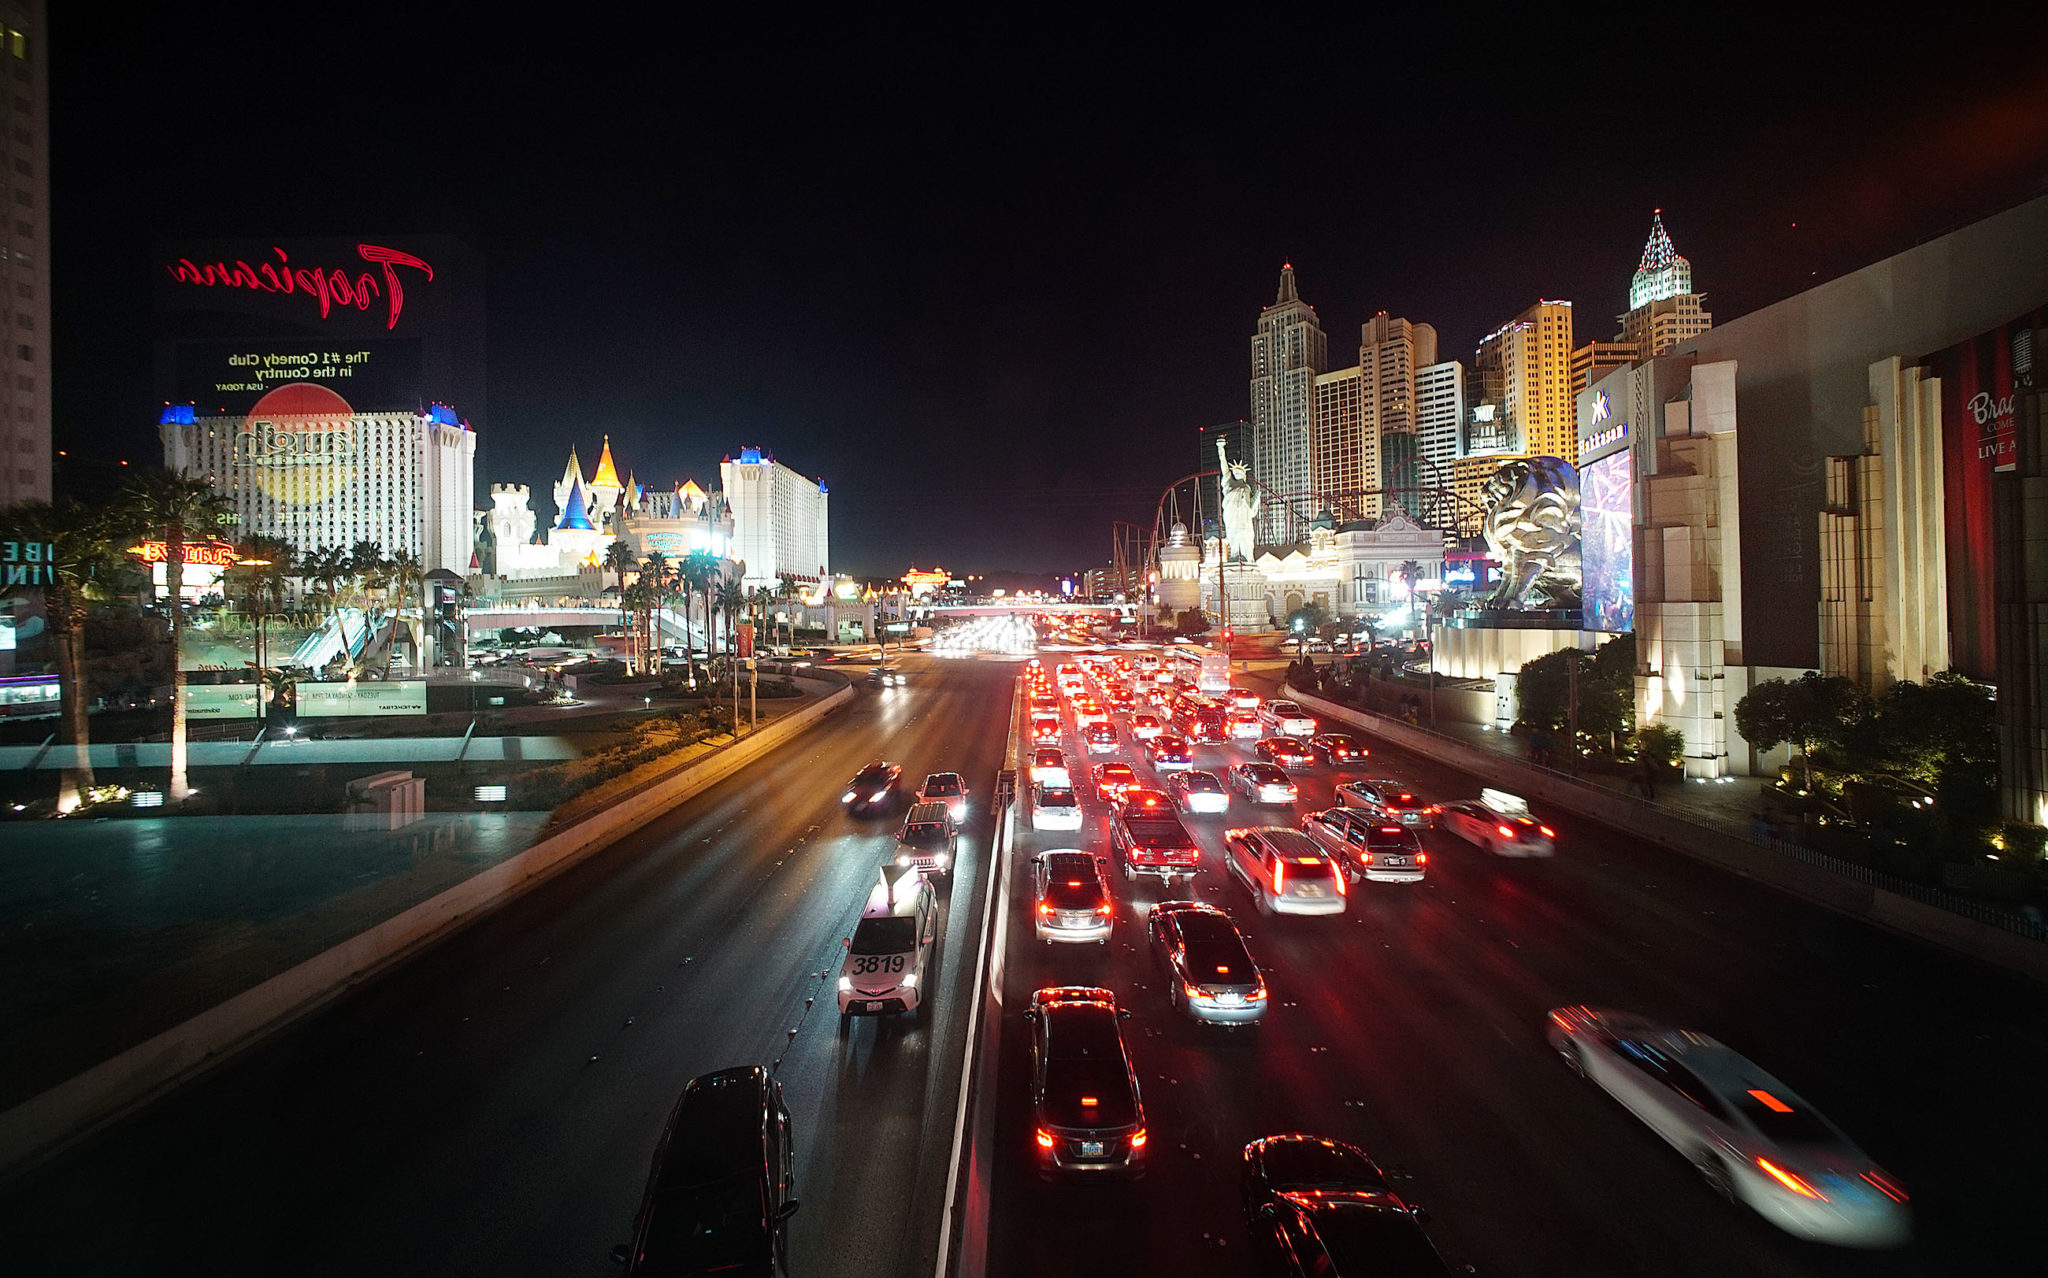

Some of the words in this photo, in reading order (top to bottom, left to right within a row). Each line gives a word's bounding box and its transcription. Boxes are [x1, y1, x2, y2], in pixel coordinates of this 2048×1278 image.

[1579, 424, 1627, 457] Hakkasan
[1978, 442, 2005, 459] LIVE
[148, 544, 231, 564] EXLIBUR
[852, 955, 905, 975] 3819
